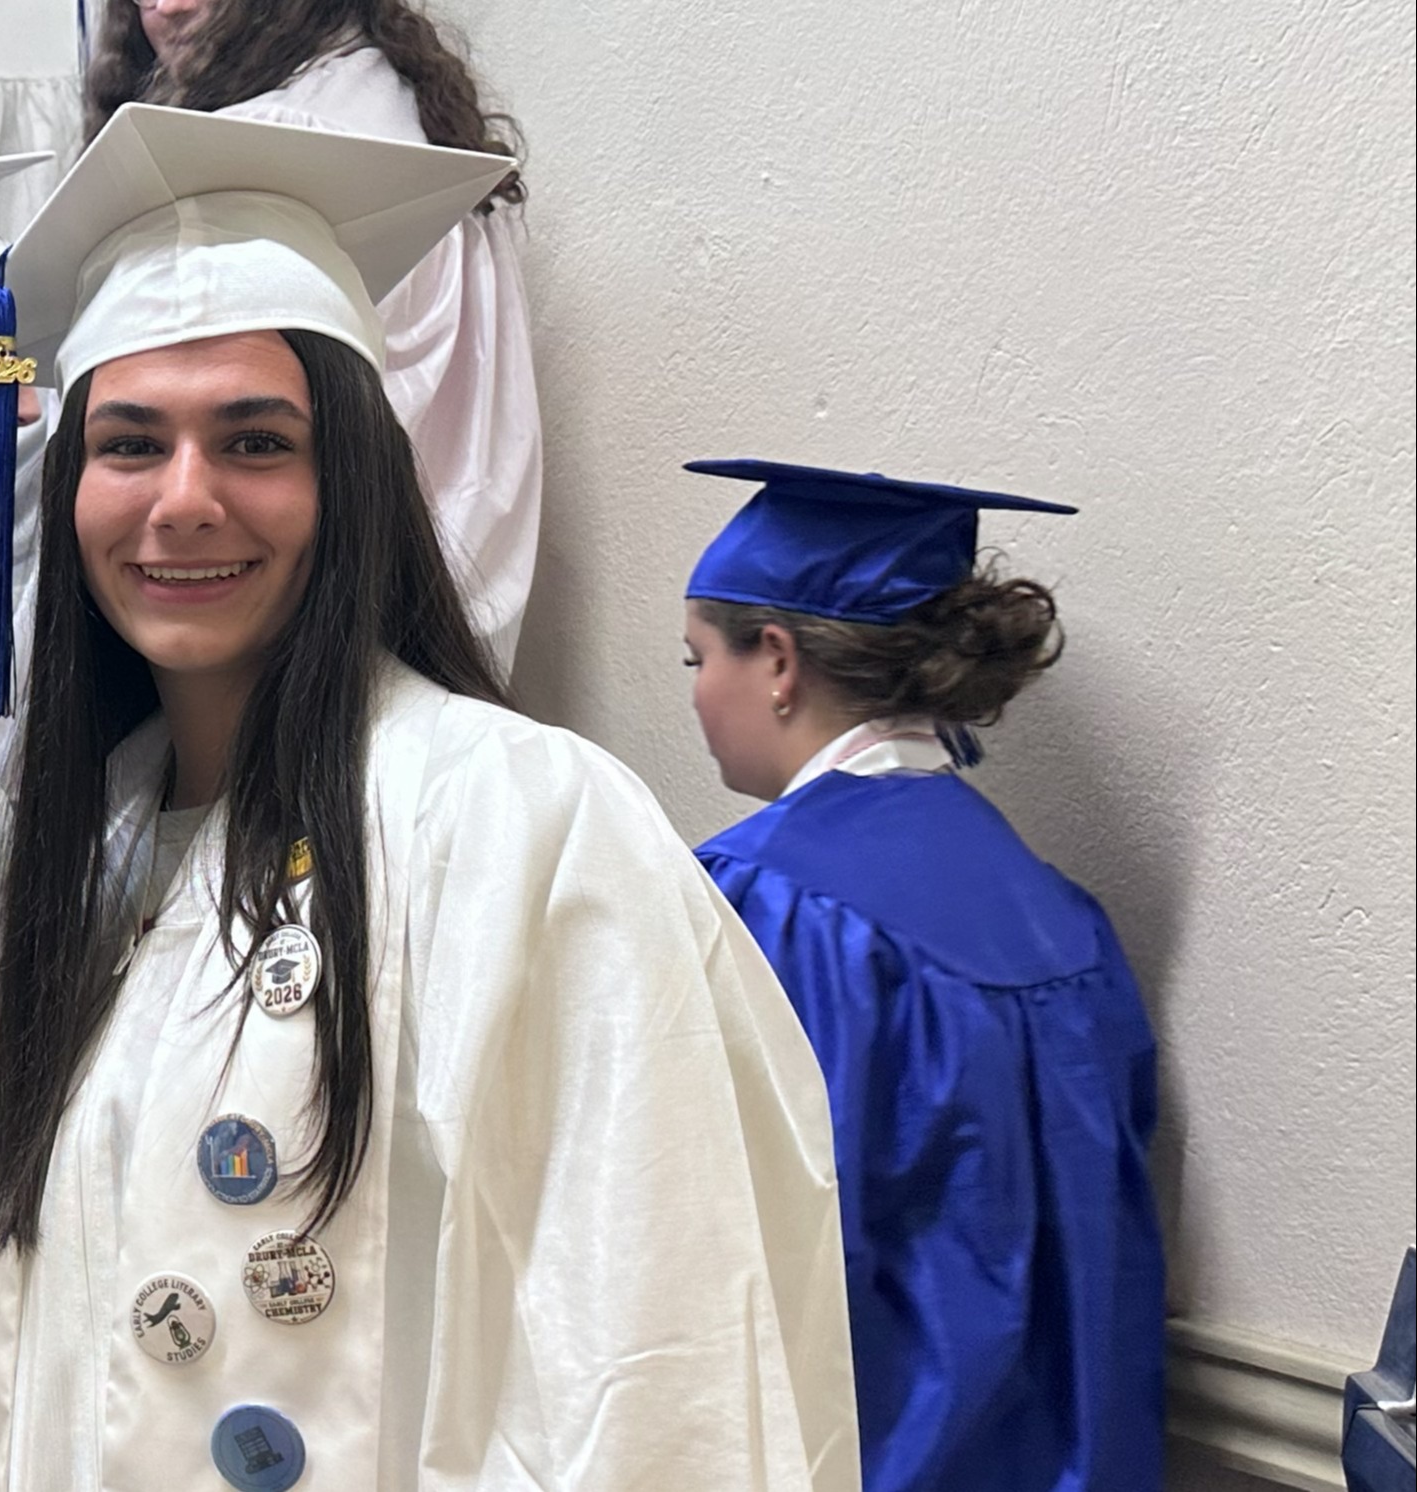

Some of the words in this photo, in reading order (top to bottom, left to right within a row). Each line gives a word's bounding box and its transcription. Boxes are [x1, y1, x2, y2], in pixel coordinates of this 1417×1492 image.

[265, 983, 302, 1007] 2026
[248, 1245, 317, 1263] DRURY-MCLA
[253, 1235, 274, 1251] EARLY
[136, 1279, 169, 1307] COLLEGE
[171, 1279, 207, 1310] LITERARY
[133, 1306, 145, 1338] EARLY
[265, 1304, 321, 1318] CHEMISTRY
[167, 1337, 206, 1361] STUDIES
